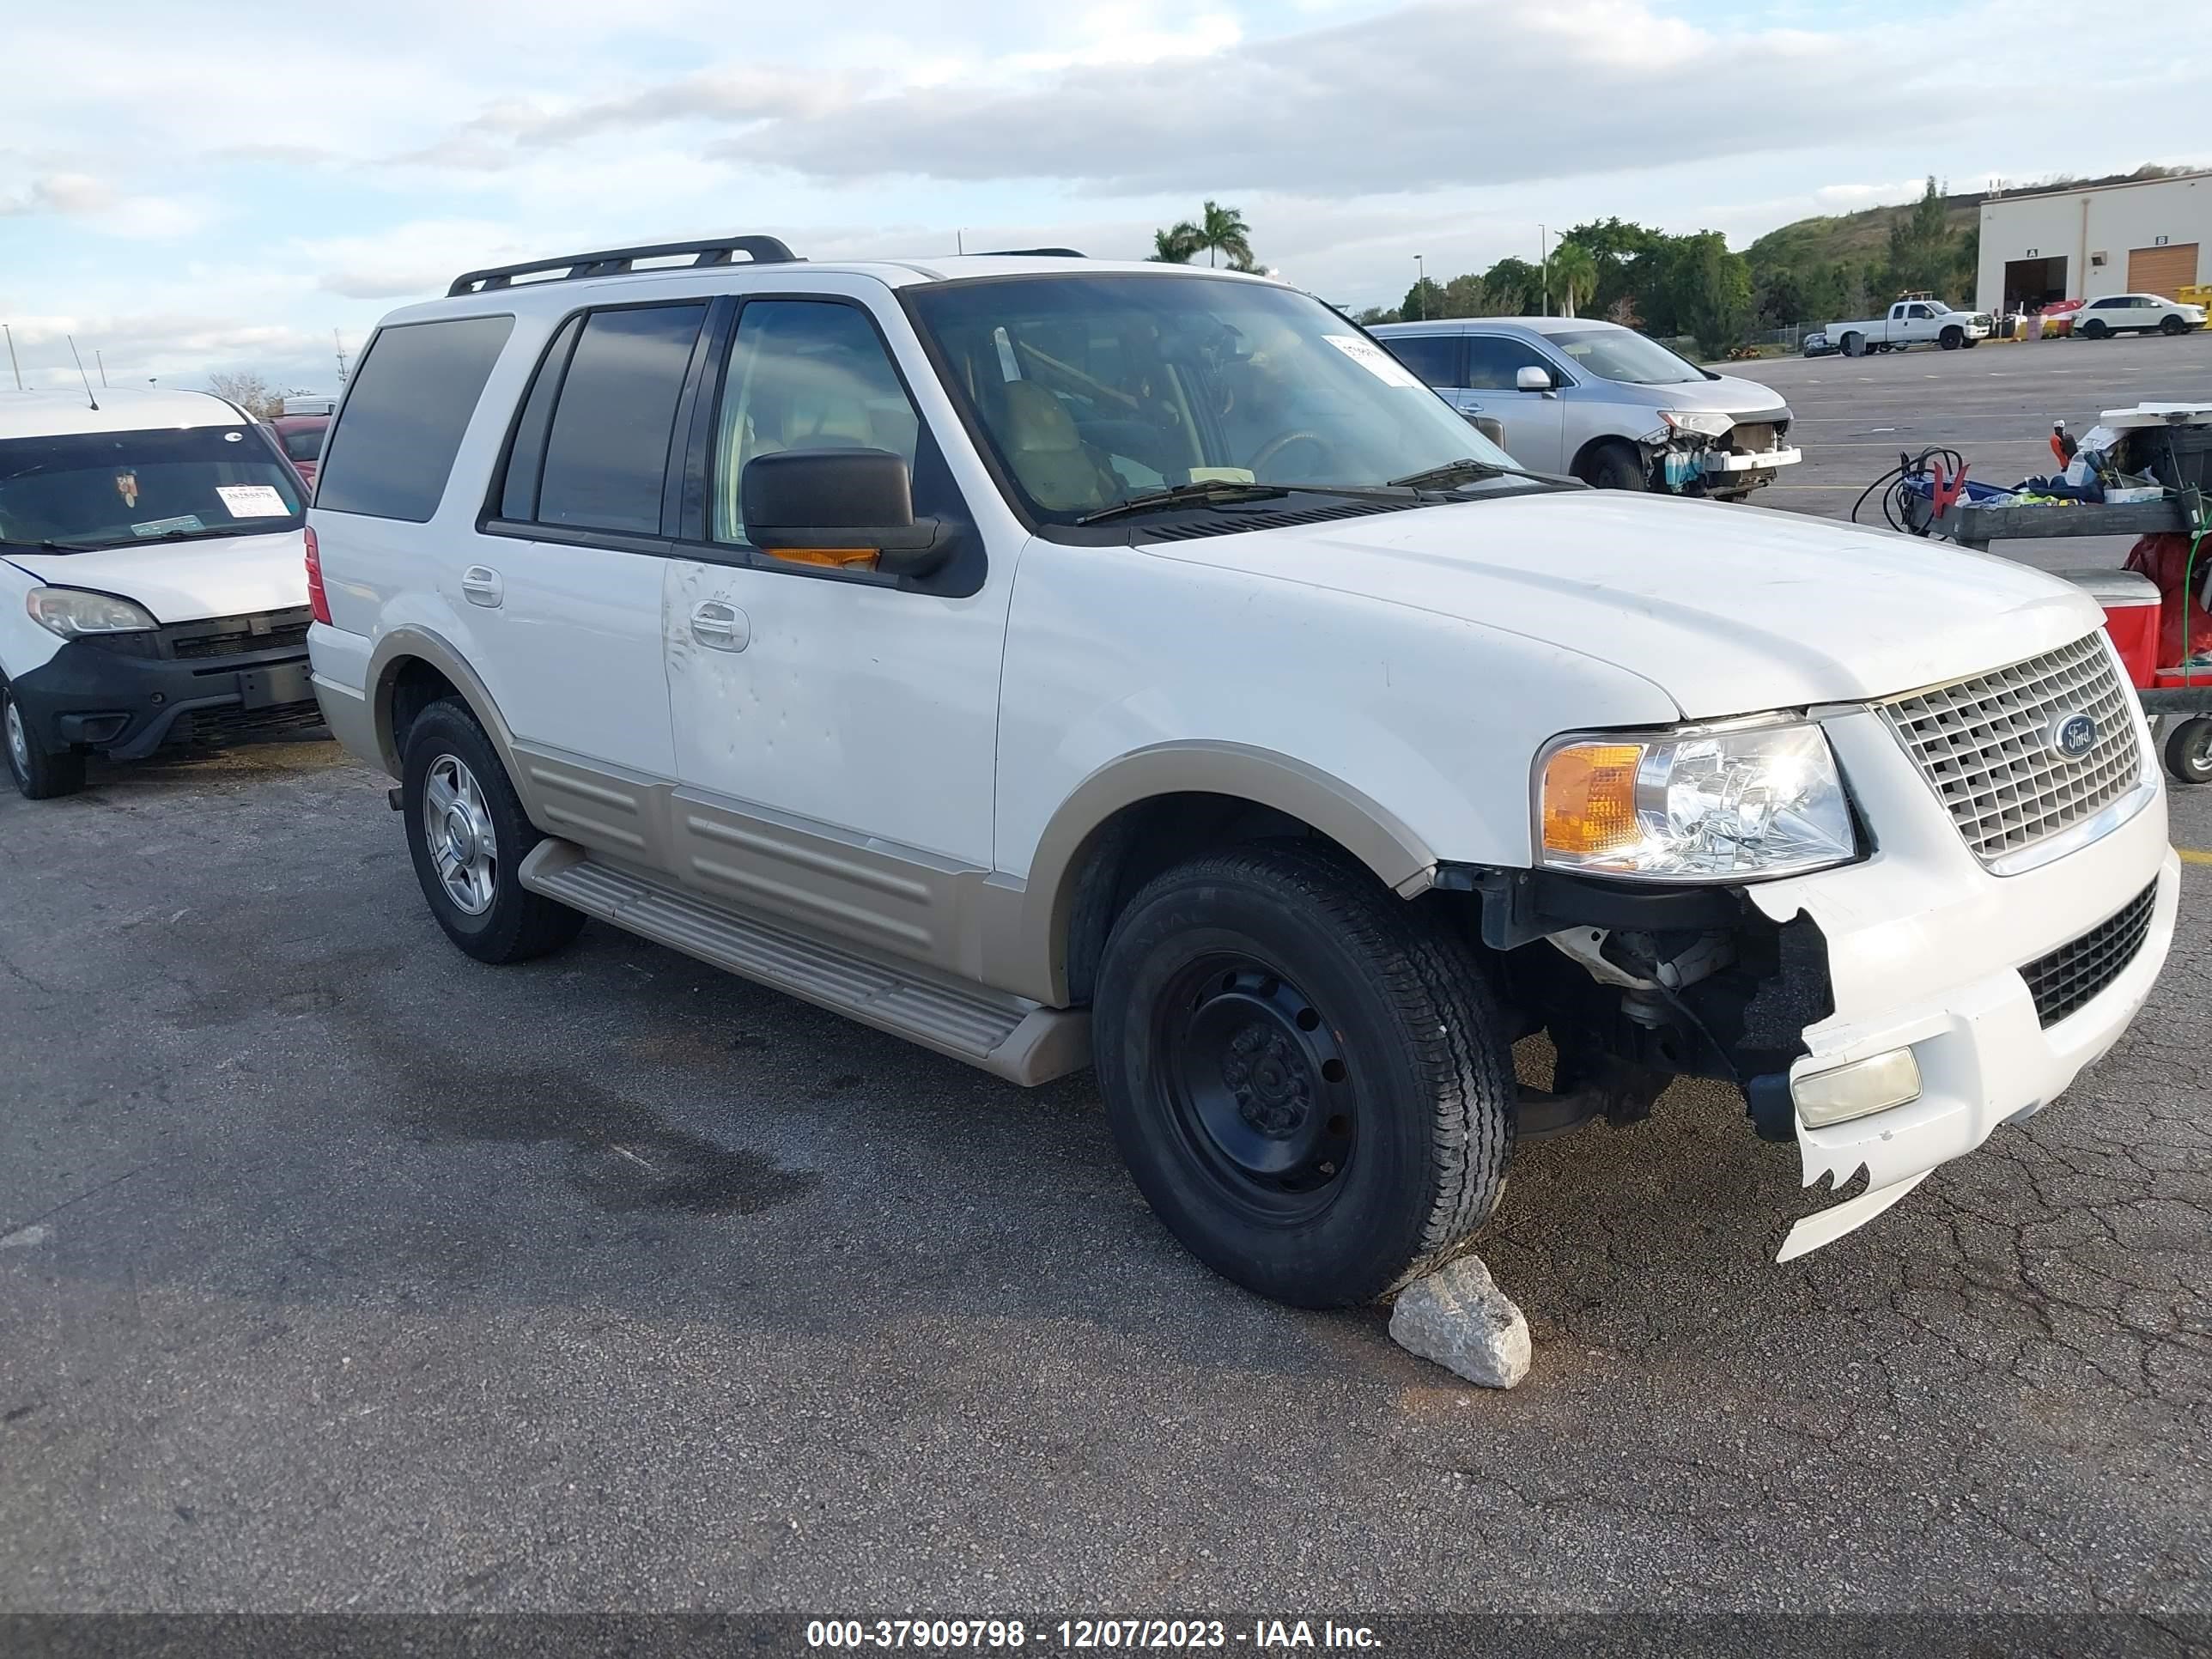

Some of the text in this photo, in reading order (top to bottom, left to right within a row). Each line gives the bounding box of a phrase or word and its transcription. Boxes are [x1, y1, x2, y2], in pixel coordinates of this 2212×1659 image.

[2157, 236, 2166, 245] B
[2028, 249, 2037, 258] A
[2068, 721, 2091, 750] Ford
